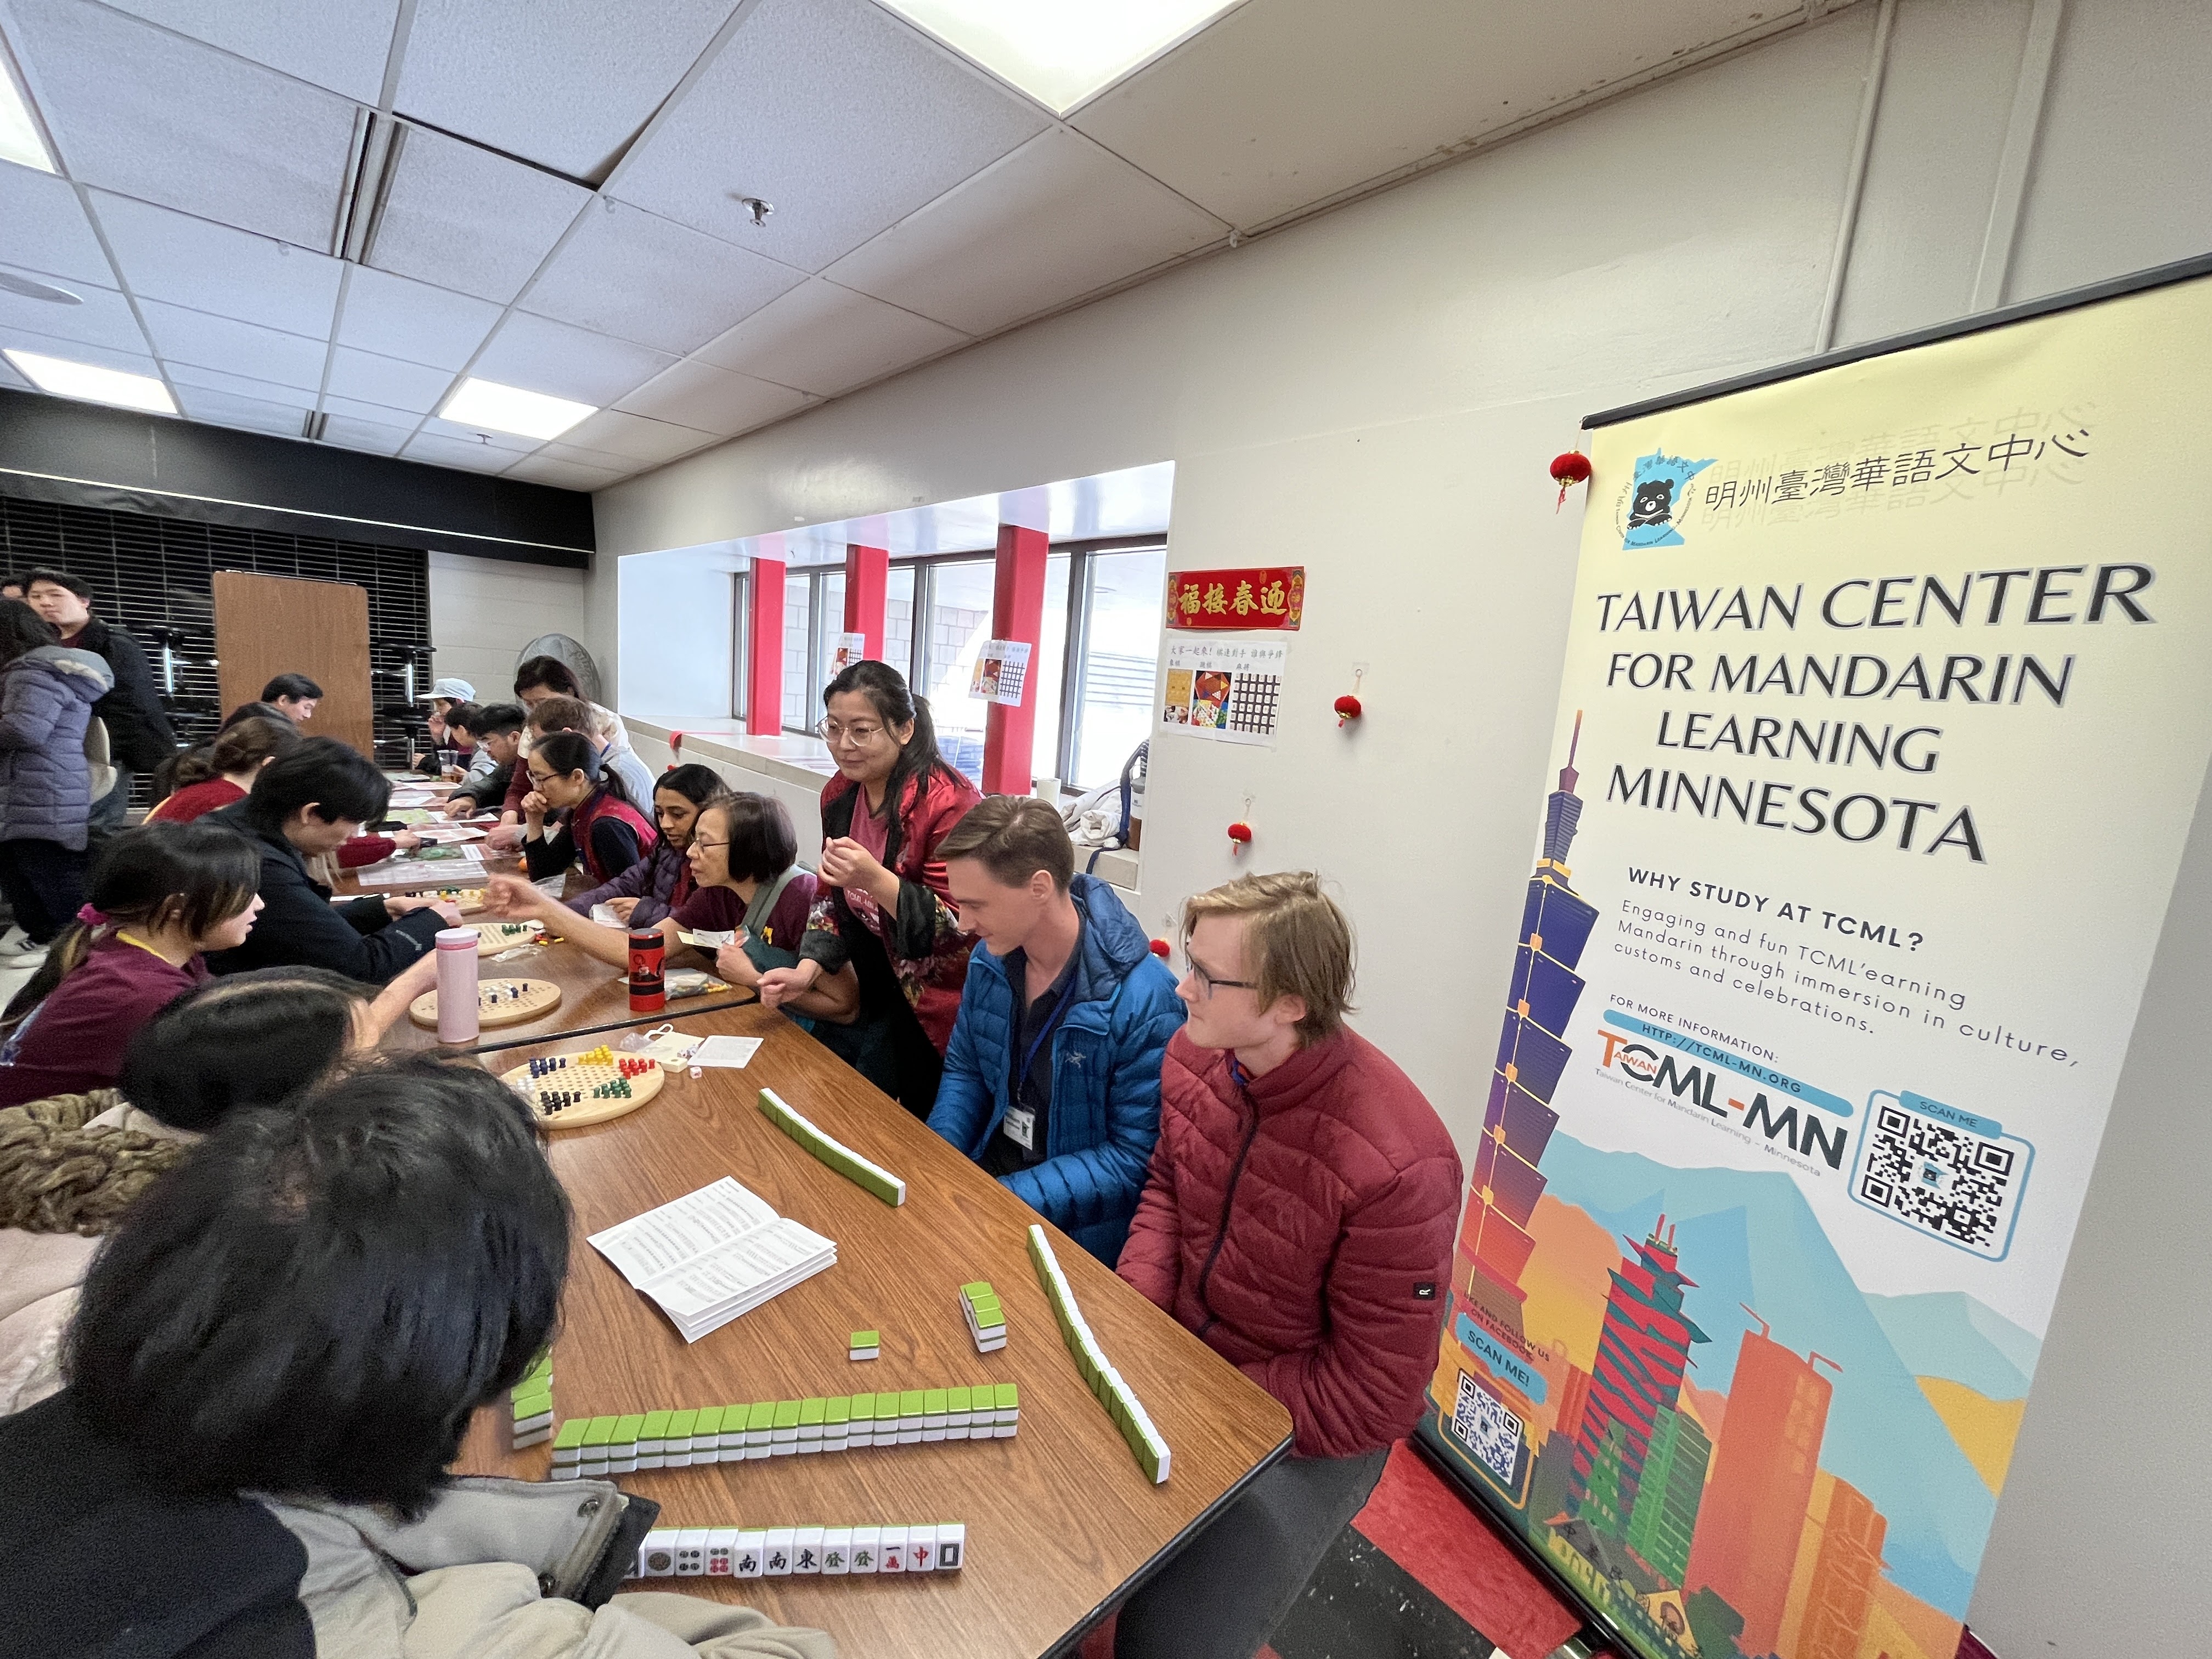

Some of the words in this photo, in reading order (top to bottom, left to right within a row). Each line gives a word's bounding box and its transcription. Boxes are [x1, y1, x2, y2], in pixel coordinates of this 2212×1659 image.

[1705, 429, 2089, 511] 明州臺灣華語文中心
[1596, 583, 1803, 632] TAIWAN
[1821, 561, 2156, 630] CENTER
[1606, 651, 1695, 691] FOR
[1711, 654, 2074, 708] MANDARIN
[1656, 710, 1944, 773] LEARNING
[1606, 764, 1987, 865] MINNESOTA
[1622, 900, 1705, 935] Engaging
[1715, 929, 1751, 944] and
[1760, 933, 1787, 955] fun
[1629, 867, 1680, 891] WHY
[1689, 881, 1769, 912] STUDY
[1777, 902, 1811, 923] AT
[1822, 911, 1923, 951] TCML?
[1615, 943, 1681, 970] customs
[1690, 964, 1724, 983] and
[1733, 979, 1874, 1033] celebrations.
[1618, 920, 1702, 953] Mandarin
[1711, 946, 1784, 979] through
[1795, 970, 1910, 1018] immersion
[1924, 1010, 1944, 1029] in
[1959, 1024, 2078, 1067] culture,
[1610, 994, 1633, 1008] FOR
[1638, 1003, 1673, 1023] MORE
[1678, 1018, 1778, 1063] INFORMATION:
[1643, 1024, 1801, 1093] HTTP://TCML-MN.ORG
[1595, 1068, 1623, 1085] Taiwan
[1625, 1081, 1652, 1098] Center
[1654, 1093, 1666, 1103] for
[1668, 1099, 1709, 1122] Mandarin
[1711, 1118, 1751, 1144] Learning
[1764, 1144, 1820, 1176] Minnesota
[1598, 1030, 1848, 1170] TCML-MN
[1920, 1101, 1955, 1120] SCAN
[1959, 1115, 1978, 1127] ME
[1471, 1308, 1483, 1322] ON
[1480, 1305, 1498, 1322] AND
[1500, 1320, 1536, 1350] FOLLOW
[1538, 1348, 1549, 1362] US
[1468, 1330, 1502, 1365] SCAN
[1505, 1359, 1530, 1387] ME!
[739, 1554, 757, 1572] 南
[769, 1551, 787, 1570] 南
[796, 1548, 817, 1569] 東
[825, 1551, 845, 1567] 發
[854, 1550, 874, 1567] 發
[913, 1546, 929, 1567] 中
